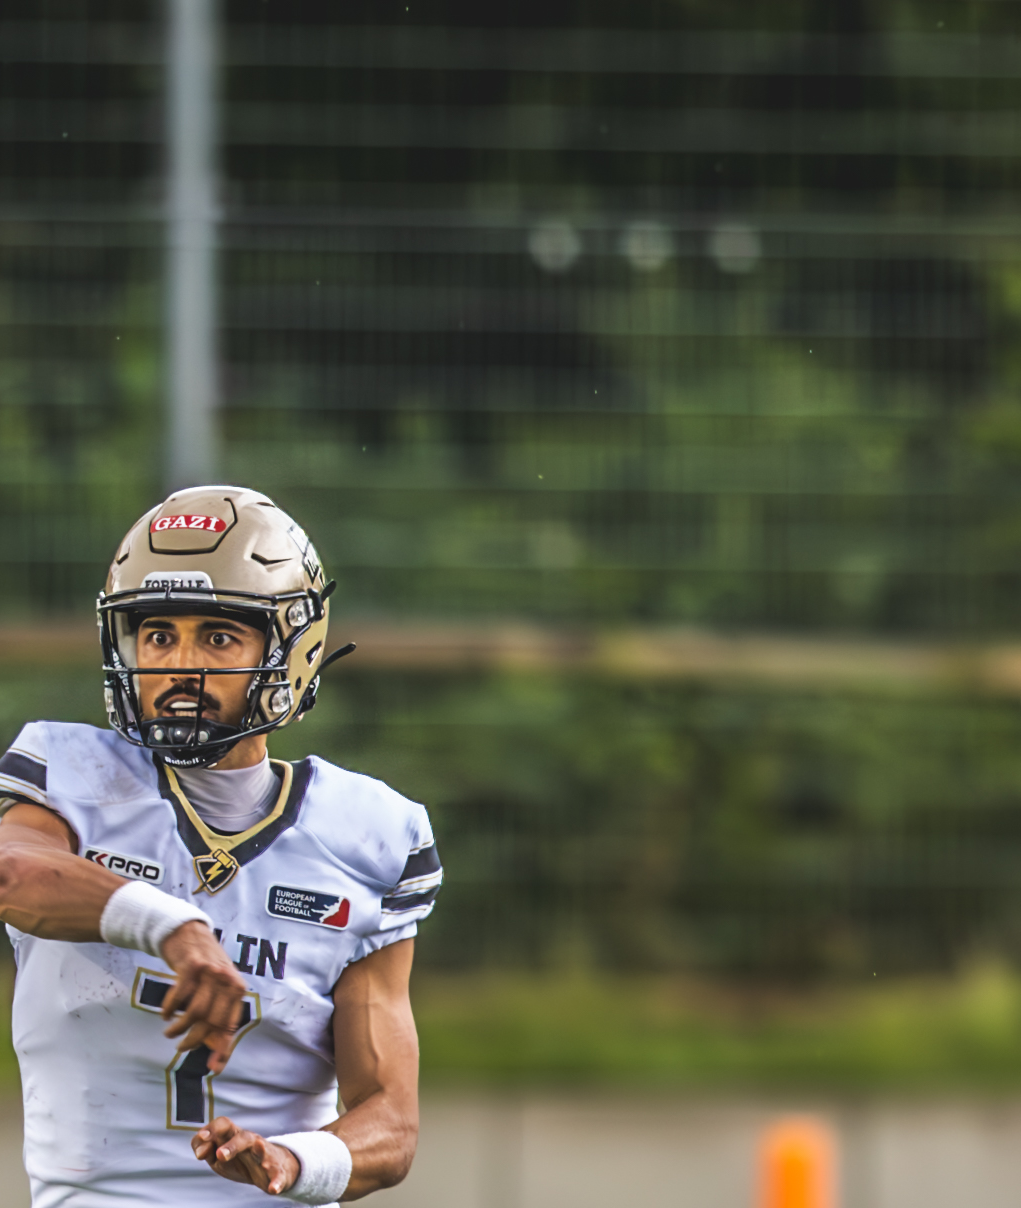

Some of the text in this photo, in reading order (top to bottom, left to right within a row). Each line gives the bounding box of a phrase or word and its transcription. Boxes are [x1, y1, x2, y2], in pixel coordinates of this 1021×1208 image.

[275, 897, 303, 908] LEAGUE
[276, 889, 316, 903] EUROPEAN
[274, 904, 312, 917] FOOTBALL
[131, 967, 262, 1130] 7
